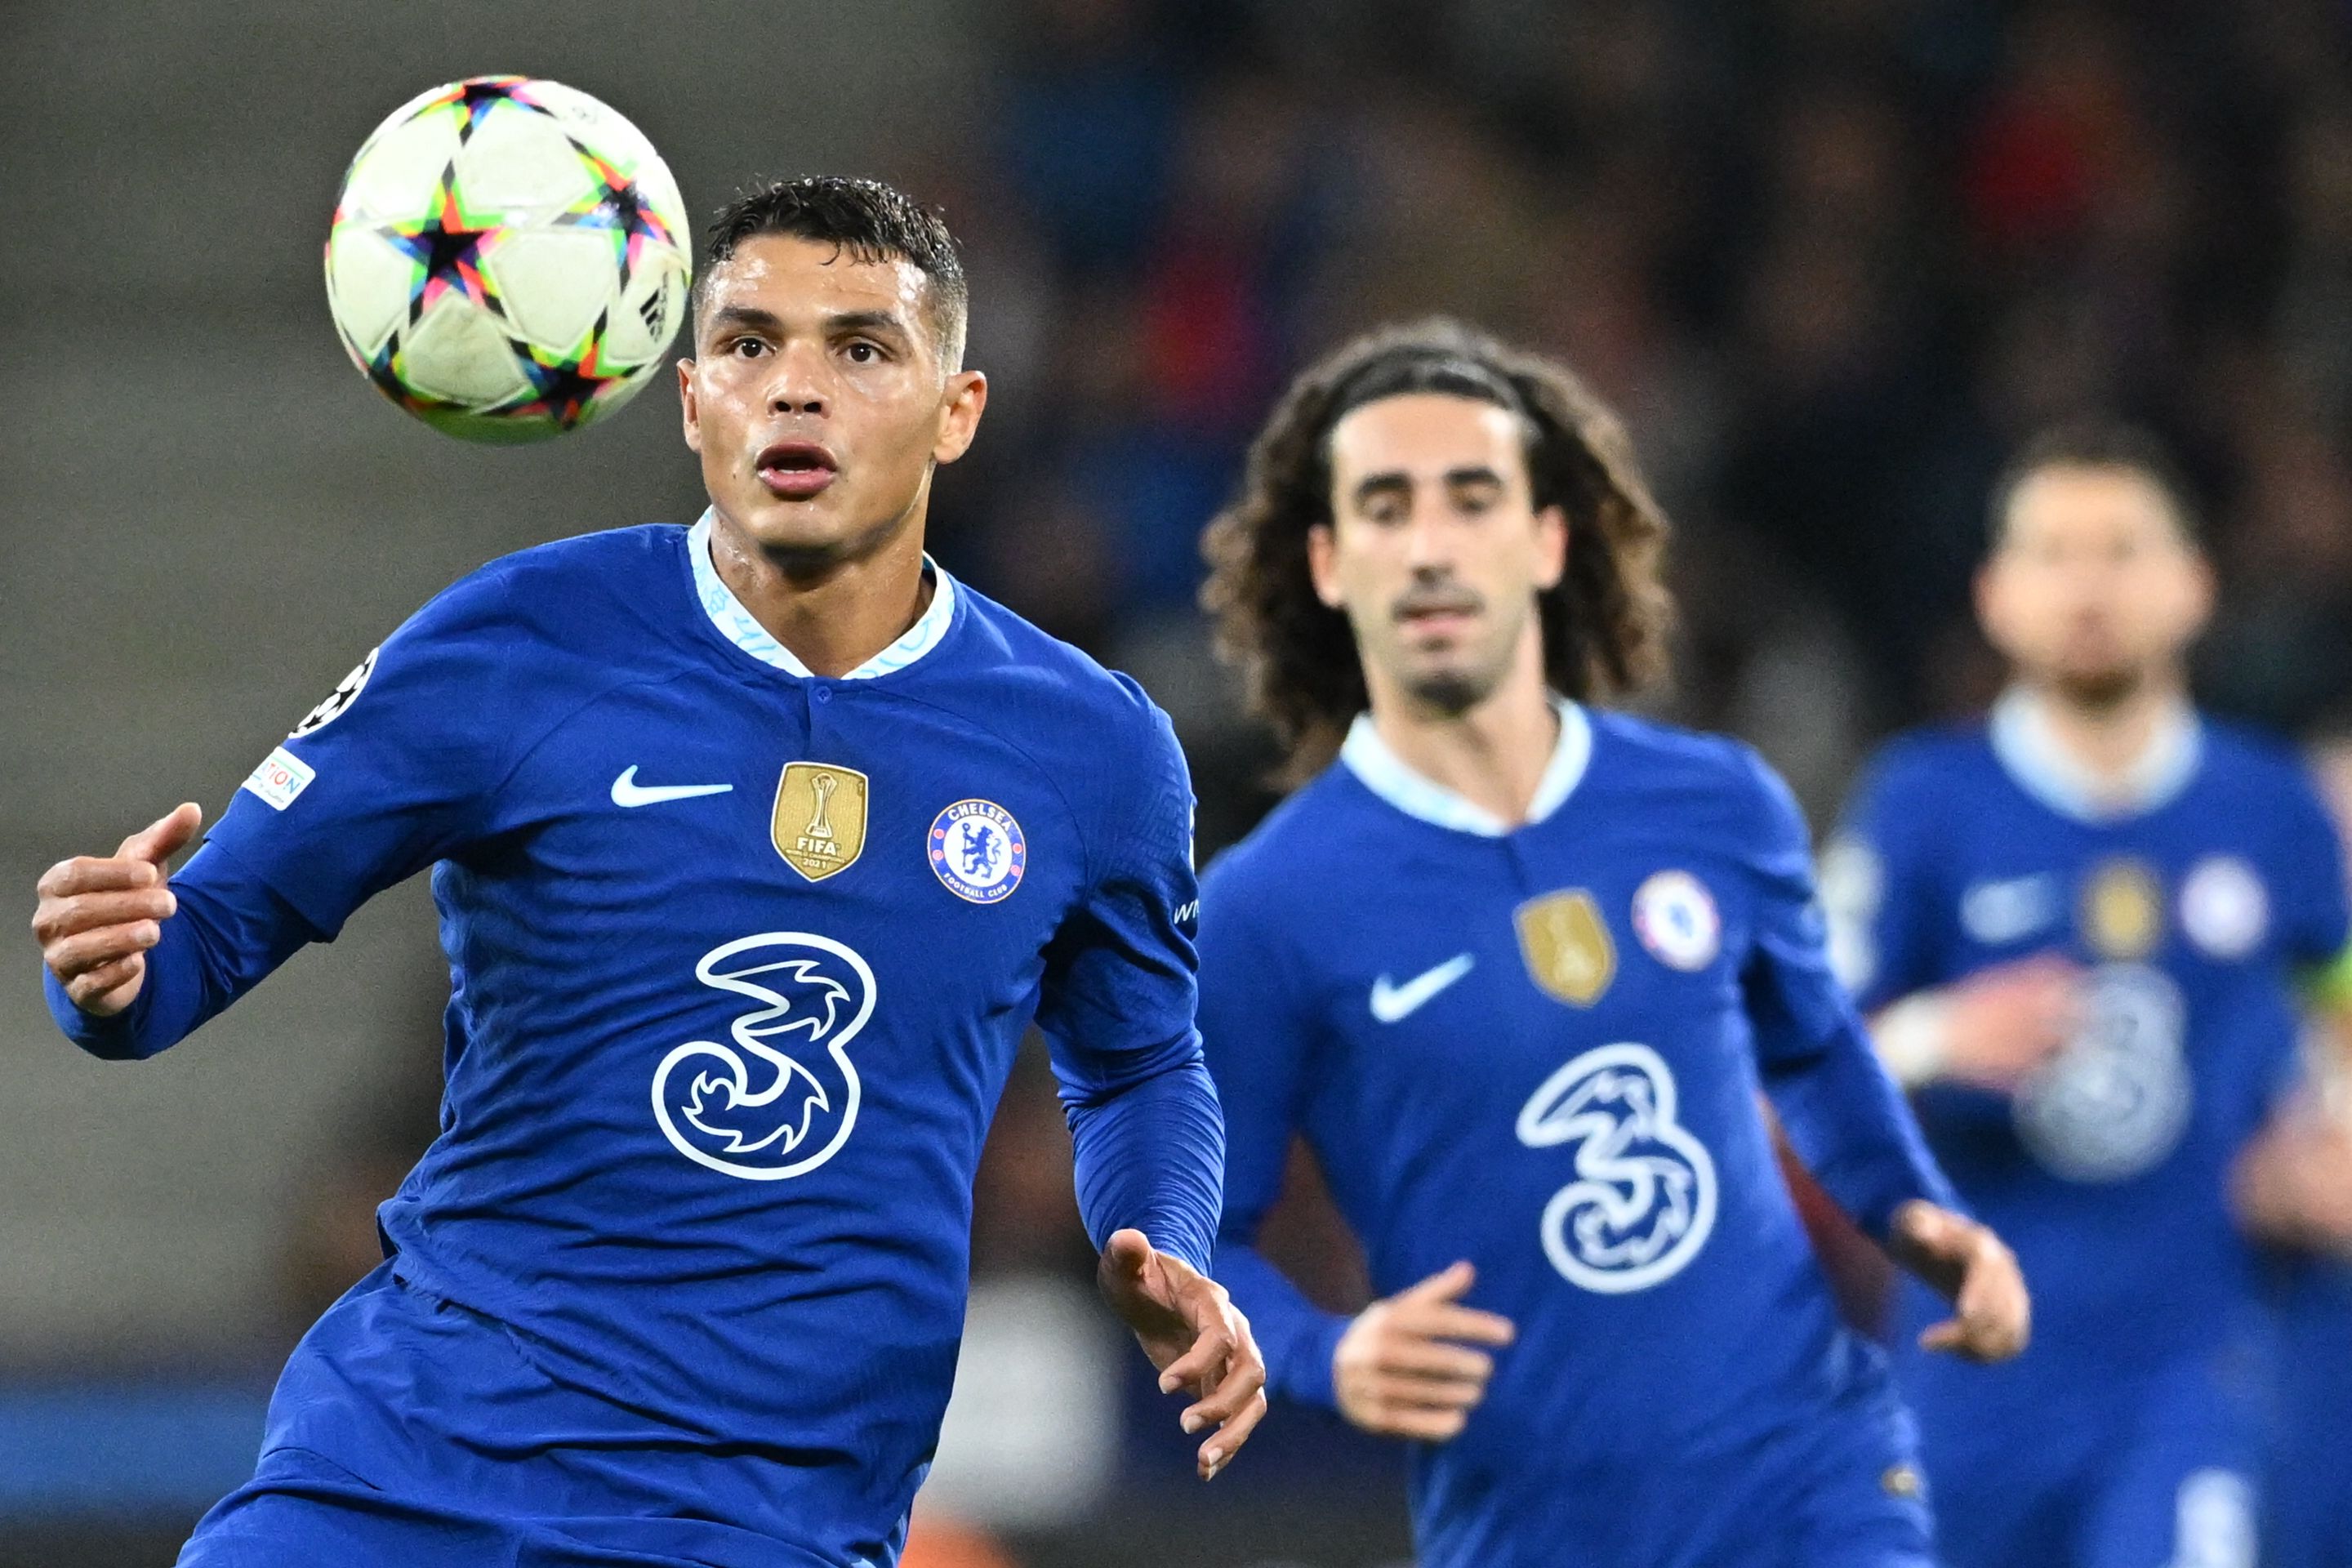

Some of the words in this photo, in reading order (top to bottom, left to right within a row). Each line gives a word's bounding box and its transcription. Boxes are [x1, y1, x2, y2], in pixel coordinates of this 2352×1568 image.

[261, 761, 301, 794] TION
[947, 803, 1012, 831] CHELSEA
[797, 836, 837, 856] FIFA
[803, 858, 827, 869] 2021
[943, 872, 985, 898] FOOTBALL
[987, 884, 1008, 898] CLUB
[651, 931, 877, 1181] 3
[1515, 1041, 1717, 1294] 3
